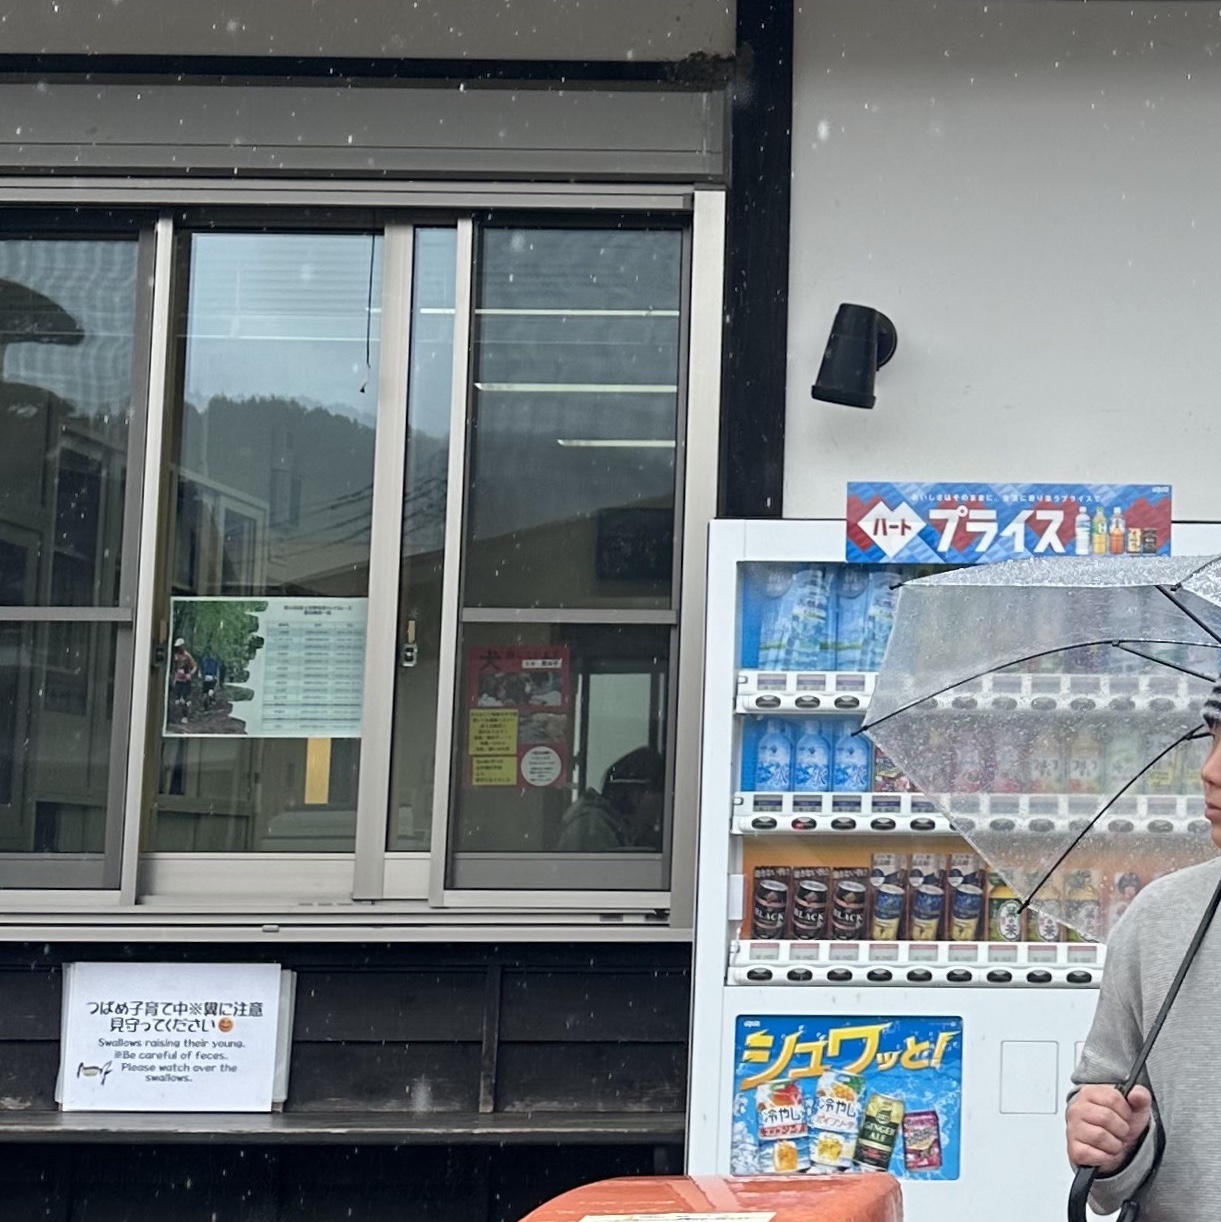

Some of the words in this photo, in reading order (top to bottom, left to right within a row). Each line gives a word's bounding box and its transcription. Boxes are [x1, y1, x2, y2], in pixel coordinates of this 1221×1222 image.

[872, 518, 913, 537] ハート
[928, 504, 1066, 554] プライス
[110, 1017, 216, 1033] 見守ってください
[98, 1038, 142, 1047] Swallows
[145, 1038, 180, 1048] raising
[184, 1038, 209, 1048] their
[212, 1040, 246, 1049] young.
[139, 1050, 178, 1060] careful
[180, 1050, 192, 1060] of
[195, 1050, 229, 1060] feces.
[740, 1022, 962, 1091] シュワッと!
[121, 1063, 156, 1072] Please
[159, 1063, 190, 1073] watch
[193, 1065, 217, 1073] over
[220, 1063, 238, 1073] the
[145, 1073, 193, 1083] swallows.
[764, 1107, 801, 1124] 冷やし
[816, 1097, 856, 1119] 冷やし
